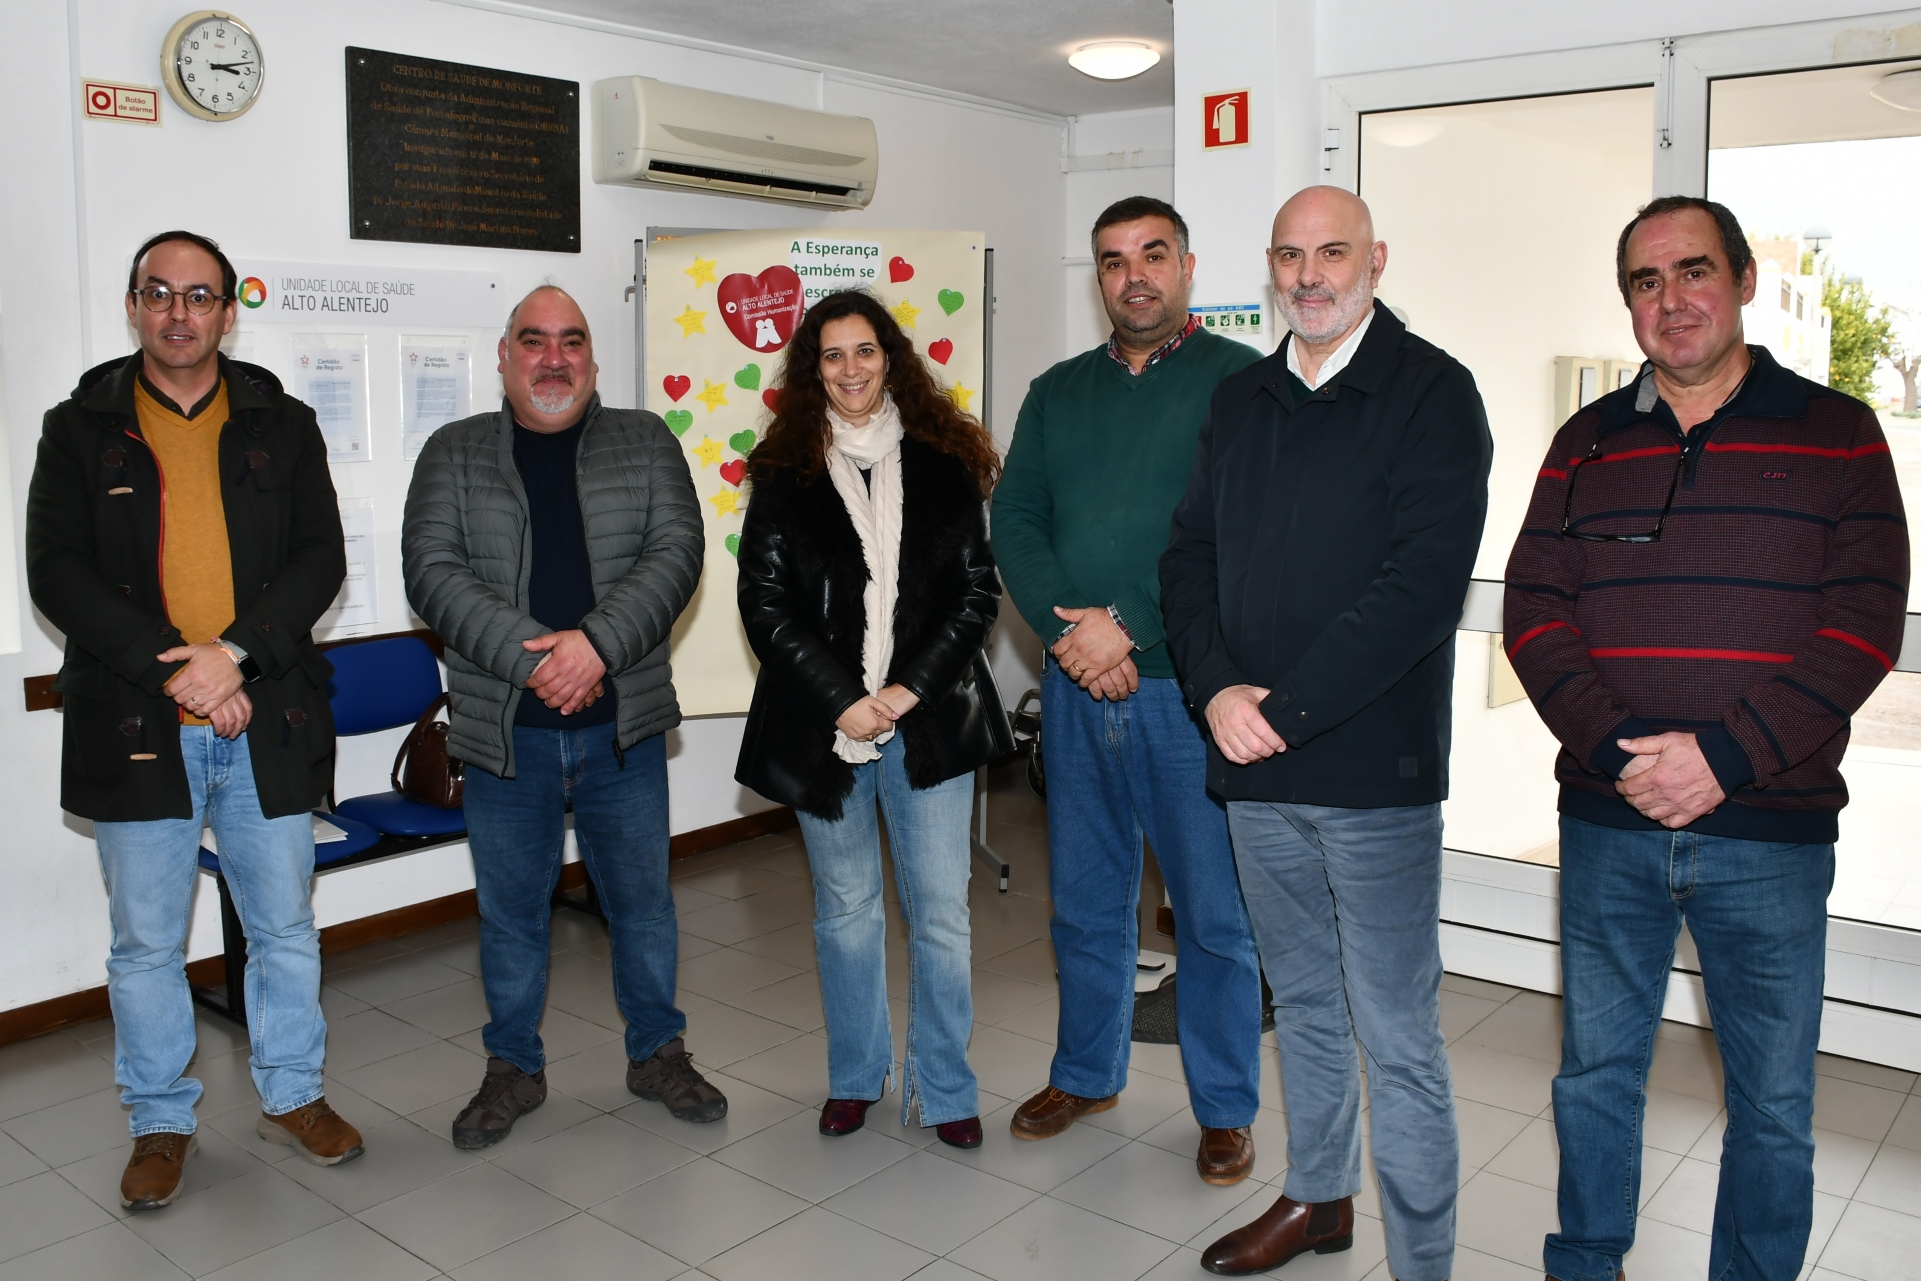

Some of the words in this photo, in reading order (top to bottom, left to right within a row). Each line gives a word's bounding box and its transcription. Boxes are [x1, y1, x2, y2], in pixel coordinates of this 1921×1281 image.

[203, 31, 209, 40] 11
[216, 29, 225, 38] 12
[190, 41, 199, 50] 10
[184, 56, 192, 65] 9
[241, 50, 248, 59] 2
[187, 73, 195, 82] 8
[243, 67, 251, 76] 3
[238, 81, 245, 90] 4
[393, 65, 432, 78] CENTRO
[434, 70, 446, 80] DE
[480, 77, 490, 87] DE
[492, 79, 542, 95] MONFORTE
[198, 88, 205, 96] 7
[226, 92, 234, 101] 5
[380, 82, 403, 94] Obra
[405, 88, 445, 100] conjunta
[448, 92, 458, 101] da
[521, 101, 555, 114] Regional
[125, 96, 146, 105] Botão
[212, 95, 219, 103] 6
[129, 105, 153, 114] alarme
[371, 101, 382, 110] de
[414, 107, 424, 115] de
[426, 107, 472, 122] Portalegre
[405, 123, 439, 136] Câmara
[441, 127, 482, 141] Municipal
[484, 133, 494, 142] de
[497, 134, 534, 147] Monforte
[404, 142, 453, 156] Inaugurado
[455, 149, 467, 158] em
[480, 151, 489, 160] de
[491, 151, 511, 162] Maio
[395, 163, 409, 171] por
[412, 164, 431, 173] suas
[535, 174, 545, 183] de
[395, 179, 425, 190] Estado
[474, 186, 509, 198] Ministro
[510, 189, 520, 198] da
[386, 196, 411, 210] Jorge
[535, 209, 563, 219] Estado
[480, 222, 511, 234] Martins
[790, 241, 801, 254] A
[806, 241, 879, 259] Esperança
[794, 263, 855, 277] também
[859, 268, 875, 278] se
[281, 278, 327, 292] UNIDADE
[330, 280, 363, 294] LOCAL
[366, 281, 380, 295] DE
[382, 280, 416, 296] SAÚDE
[281, 294, 316, 311] ALTO
[321, 296, 389, 313] ALENTEJO
[741, 296, 759, 305] UNIDADE
[742, 302, 756, 311] ALTO
[757, 297, 785, 308] ALENTEJO
[744, 310, 767, 320] Comissão
[767, 304, 799, 315] Humanização
